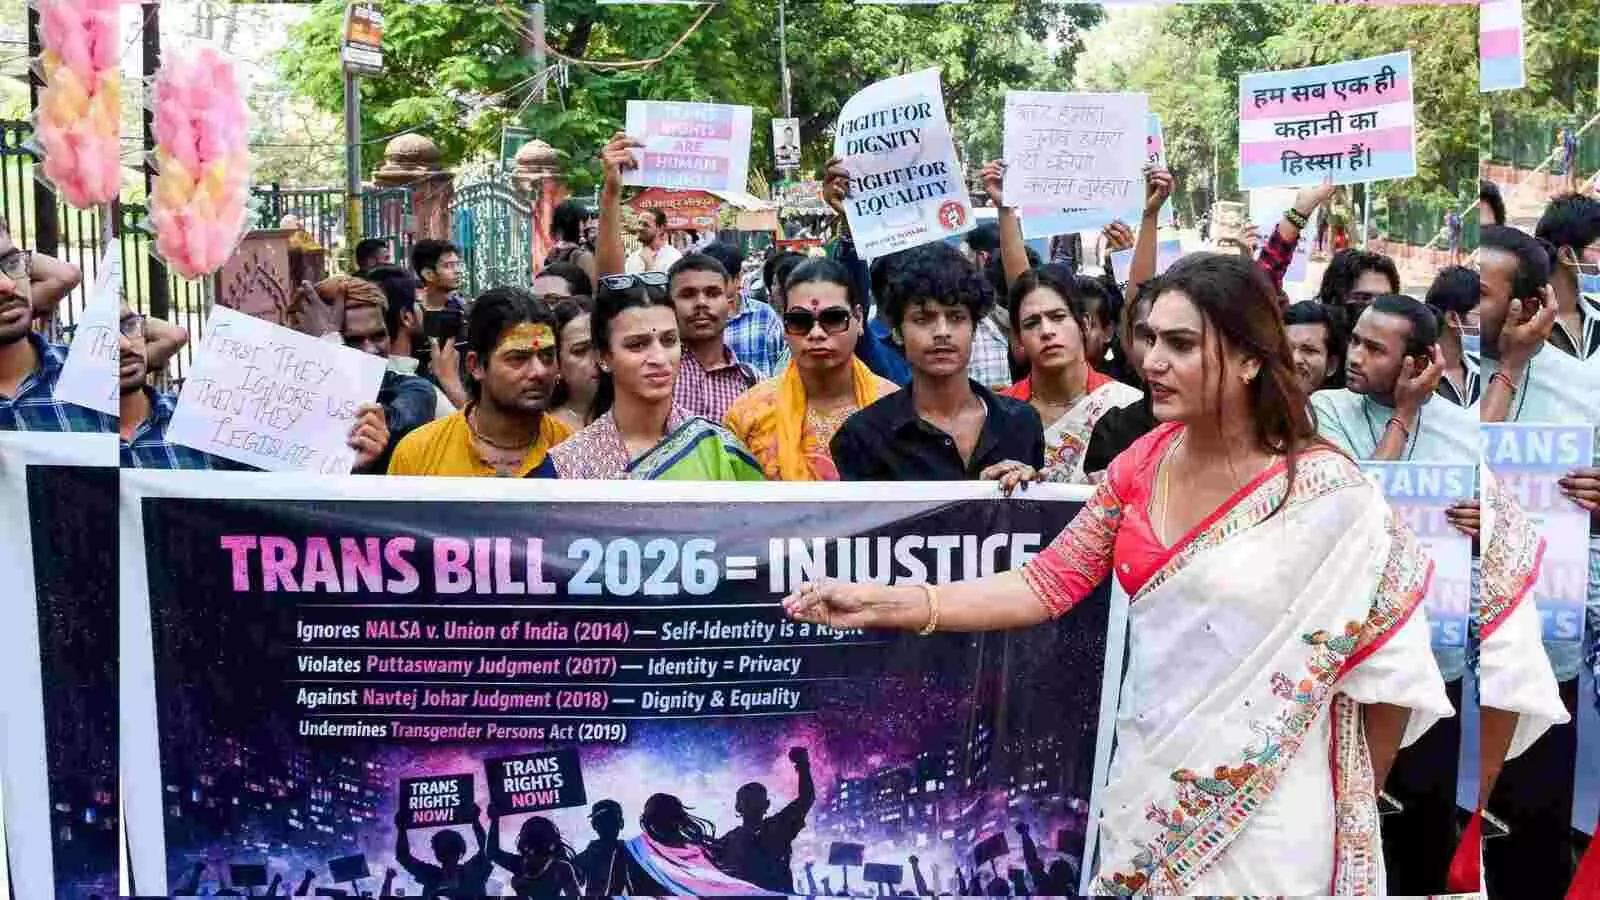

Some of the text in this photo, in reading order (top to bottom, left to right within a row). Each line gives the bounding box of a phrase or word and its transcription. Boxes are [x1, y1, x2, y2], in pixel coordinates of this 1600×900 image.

[1252, 65, 1396, 108] हम सब एक ही
[891, 102, 932, 124] FOR
[1274, 110, 1378, 140] कहानी का
[847, 128, 920, 156] DIGNITY
[656, 155, 717, 169] HUMAN
[905, 161, 947, 181] FOR
[1281, 150, 1343, 176] हिस्सा
[855, 180, 948, 217] EQUALITY
[220, 535, 421, 595] TRANS
[433, 537, 557, 595] BILL
[567, 537, 719, 596] 2026
[296, 620, 360, 642] Ignores
[365, 620, 421, 639] NALSA
[426, 625, 440, 639] v.
[444, 620, 495, 640] Union
[501, 620, 520, 640] of
[524, 621, 568, 640] India
[574, 621, 629, 643] (2014)
[661, 619, 775, 642] Self-Identity
[780, 619, 794, 637] is
[799, 622, 810, 637] a
[297, 655, 361, 672] Violates
[366, 655, 472, 677] Puttaswamy
[476, 656, 560, 678] Judgment
[566, 656, 616, 677] (2017)
[648, 657, 718, 678] Identity
[739, 655, 802, 675] Privacy
[297, 688, 358, 708] Against
[363, 688, 418, 710] Navtej
[421, 689, 469, 707] Johar
[472, 689, 551, 711] Judgment
[556, 690, 608, 710] (2018)
[641, 690, 705, 712] Dignity
[710, 690, 724, 707] &
[730, 688, 800, 710] Equality
[299, 720, 627, 742] Undermines Transgender Persons Act (2019)
[502, 757, 559, 777] TRANS
[410, 780, 458, 795] TRANS
[503, 774, 564, 793] RIGHTS
[409, 794, 460, 810] RIGHTS
[512, 790, 561, 808] NOW!
[413, 808, 454, 823] NOW!
